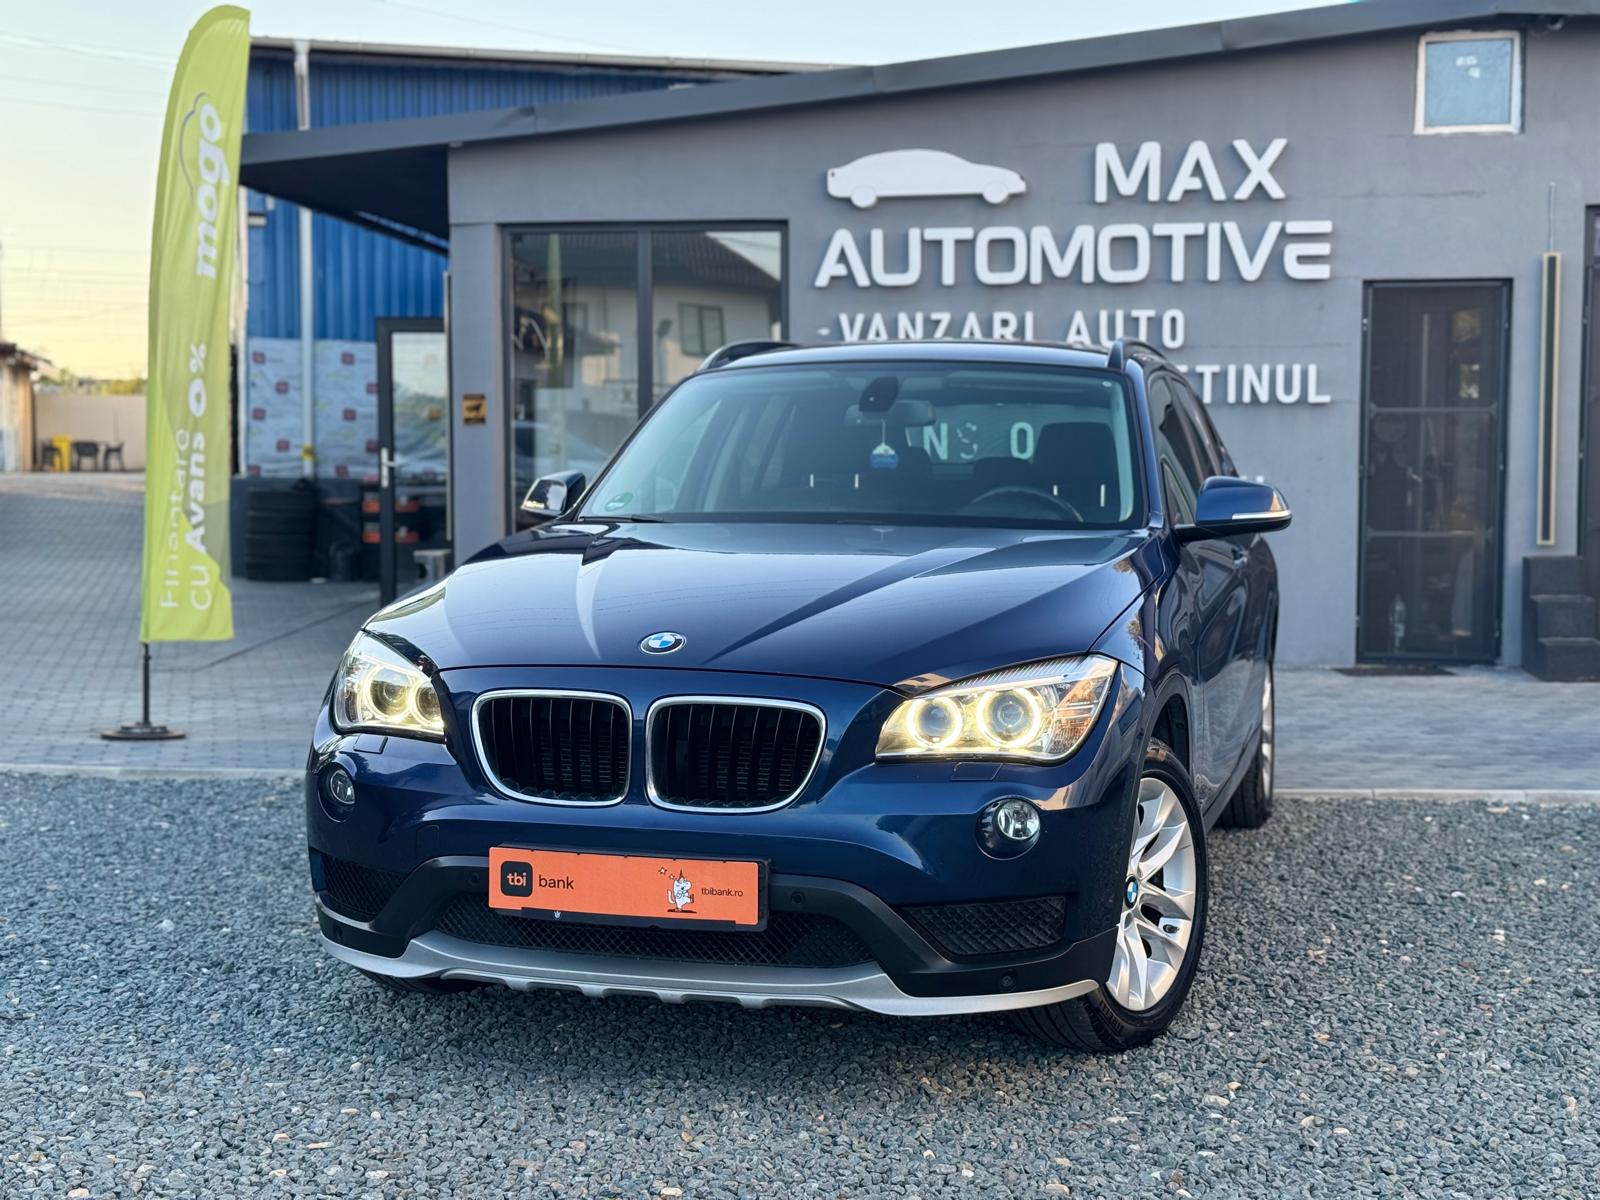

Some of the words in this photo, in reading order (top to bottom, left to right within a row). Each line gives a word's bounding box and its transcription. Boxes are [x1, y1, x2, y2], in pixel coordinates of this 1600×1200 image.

[196, 103, 230, 279] mogo
[1094, 138, 1288, 203] MAX
[814, 220, 1333, 288] AUTOMOTIVE
[1065, 308, 1186, 349] AUTO
[1176, 363, 1332, 404] TINUL
[185, 431, 206, 555] Avans
[506, 872, 527, 887] tbi
[538, 873, 575, 890] bank
[701, 887, 744, 897] tbibank.ro
